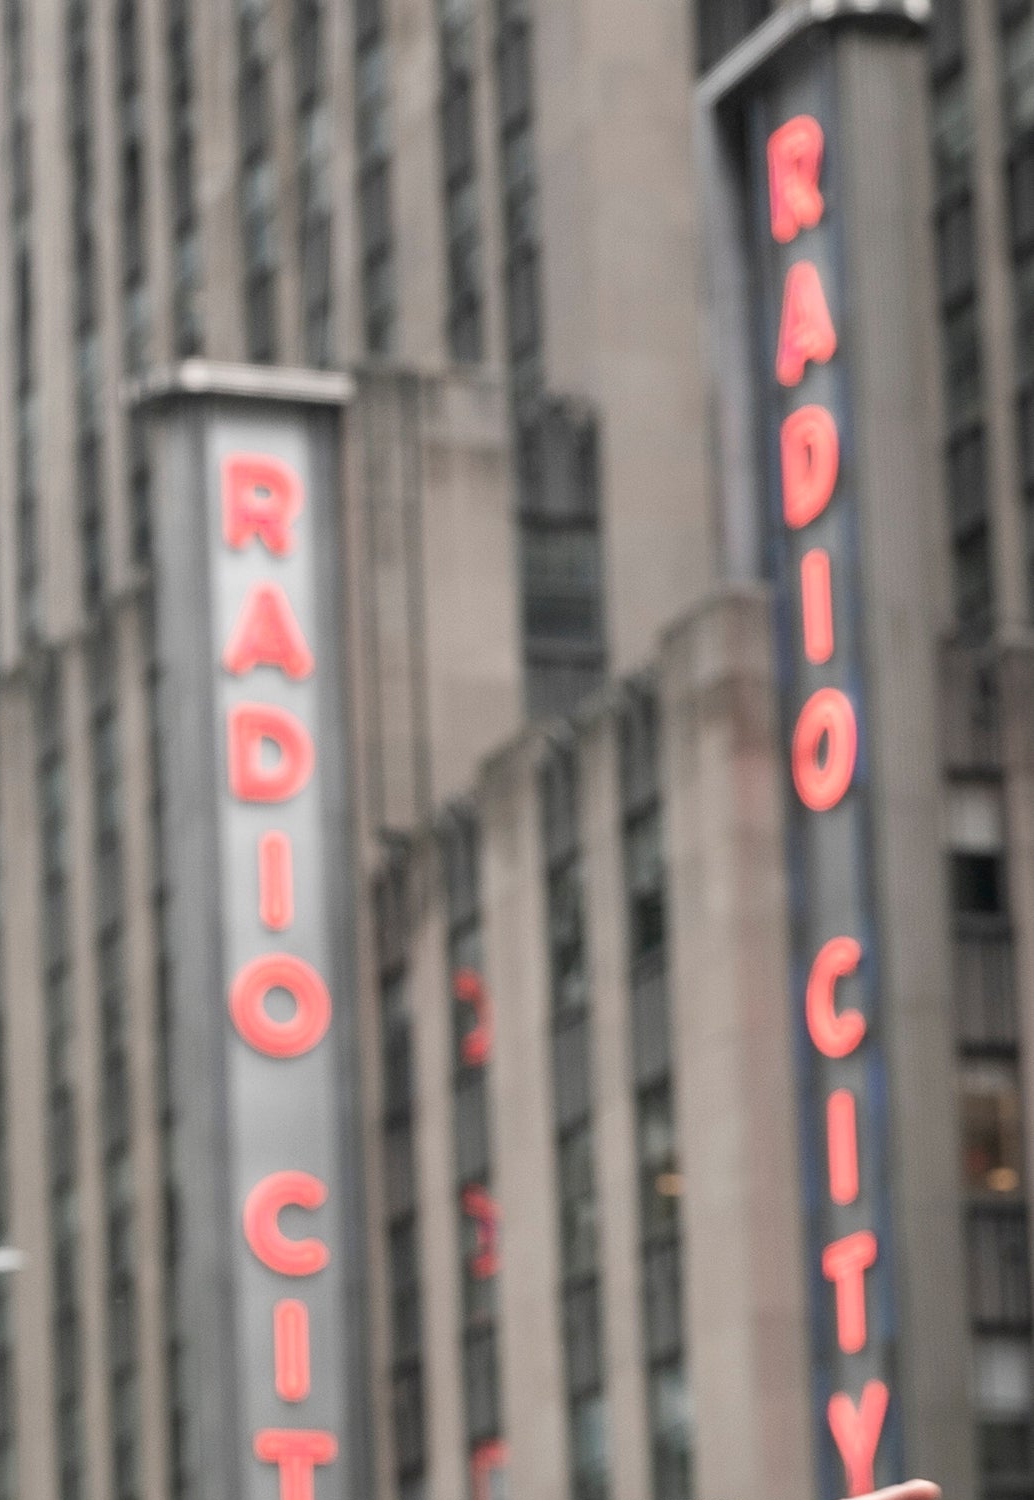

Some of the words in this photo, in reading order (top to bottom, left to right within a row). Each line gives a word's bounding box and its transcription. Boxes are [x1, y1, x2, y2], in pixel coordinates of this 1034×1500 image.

[220, 451, 334, 1058] RADIO
[764, 112, 858, 813] RADIO
[804, 935, 891, 1498] CITY
